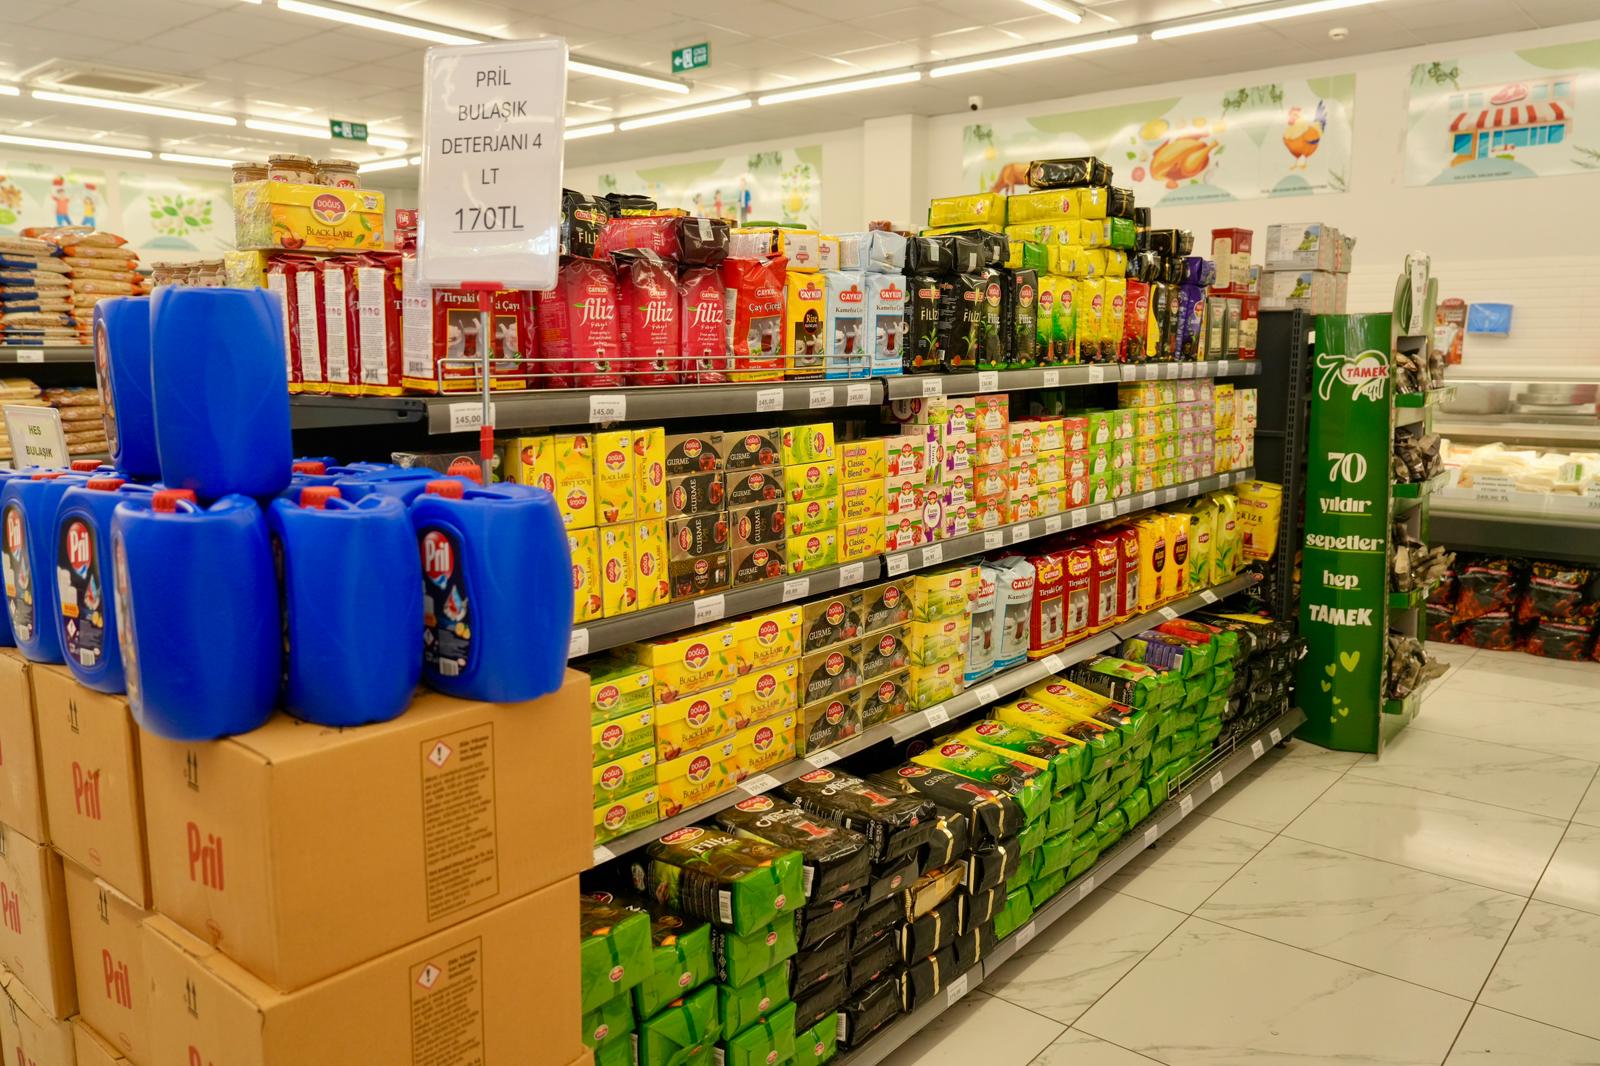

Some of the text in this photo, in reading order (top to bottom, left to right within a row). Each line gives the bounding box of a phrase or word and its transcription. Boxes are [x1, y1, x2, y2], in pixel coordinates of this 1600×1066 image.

[477, 66, 511, 87] PRİL
[459, 101, 527, 123] BULAŞIK
[442, 134, 542, 154] DETERJANI 4
[482, 169, 499, 184] LT
[455, 206, 524, 230] 170TL
[443, 293, 475, 305] Tiryaki
[503, 301, 519, 311] Çayı
[580, 298, 616, 326] filiz
[643, 303, 673, 328] filiz
[691, 303, 723, 328] filiz
[1347, 367, 1388, 377] TAMEK
[667, 458, 689, 466] GURME
[1328, 452, 1367, 483] 70
[1320, 497, 1372, 513] yıldır
[70, 531, 89, 563] Pril
[1306, 534, 1384, 551] sepetler
[425, 539, 449, 572] Pril
[1323, 570, 1359, 590] hep
[1309, 604, 1373, 626] TAMEK
[72, 762, 102, 821] Pril
[187, 821, 225, 892] Pril
[1, 881, 22, 935] Pril
[102, 948, 132, 1010] Pril
